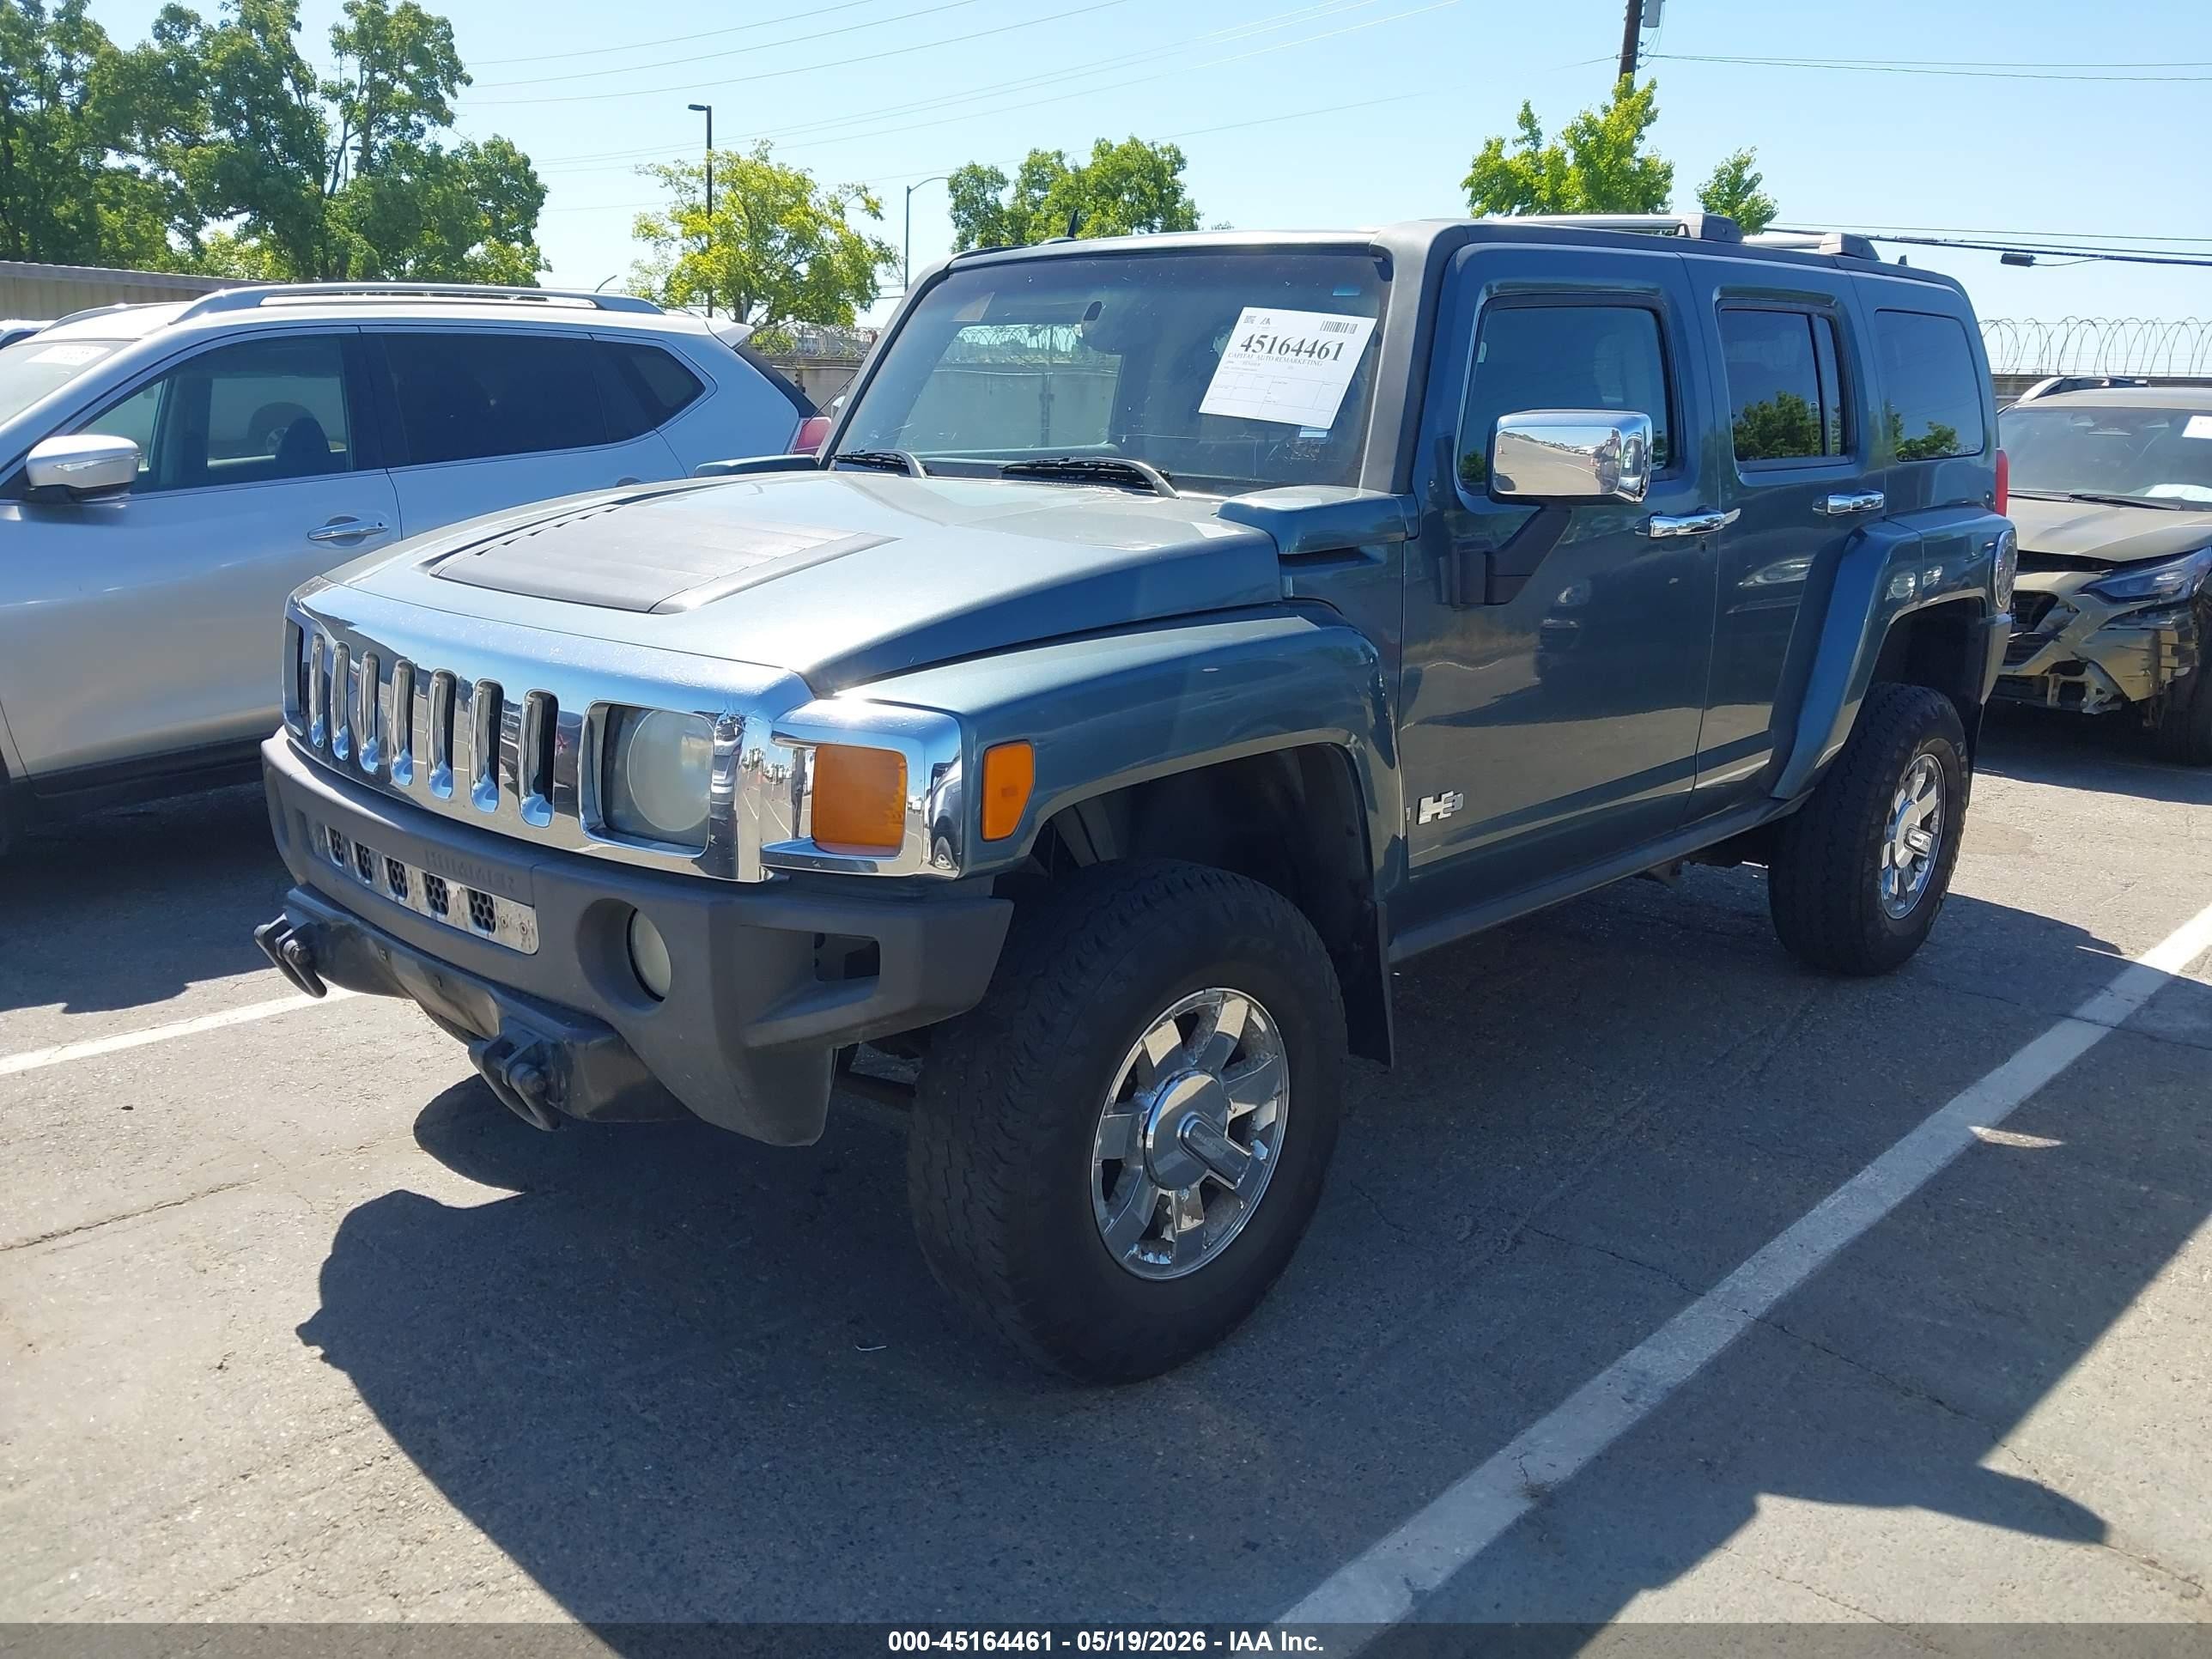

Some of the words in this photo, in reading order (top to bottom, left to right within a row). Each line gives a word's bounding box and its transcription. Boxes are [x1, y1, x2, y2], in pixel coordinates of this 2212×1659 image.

[1241, 334, 1345, 361] 45164461
[1275, 356, 1323, 367] REMARKETING
[1418, 790, 1463, 824] H3
